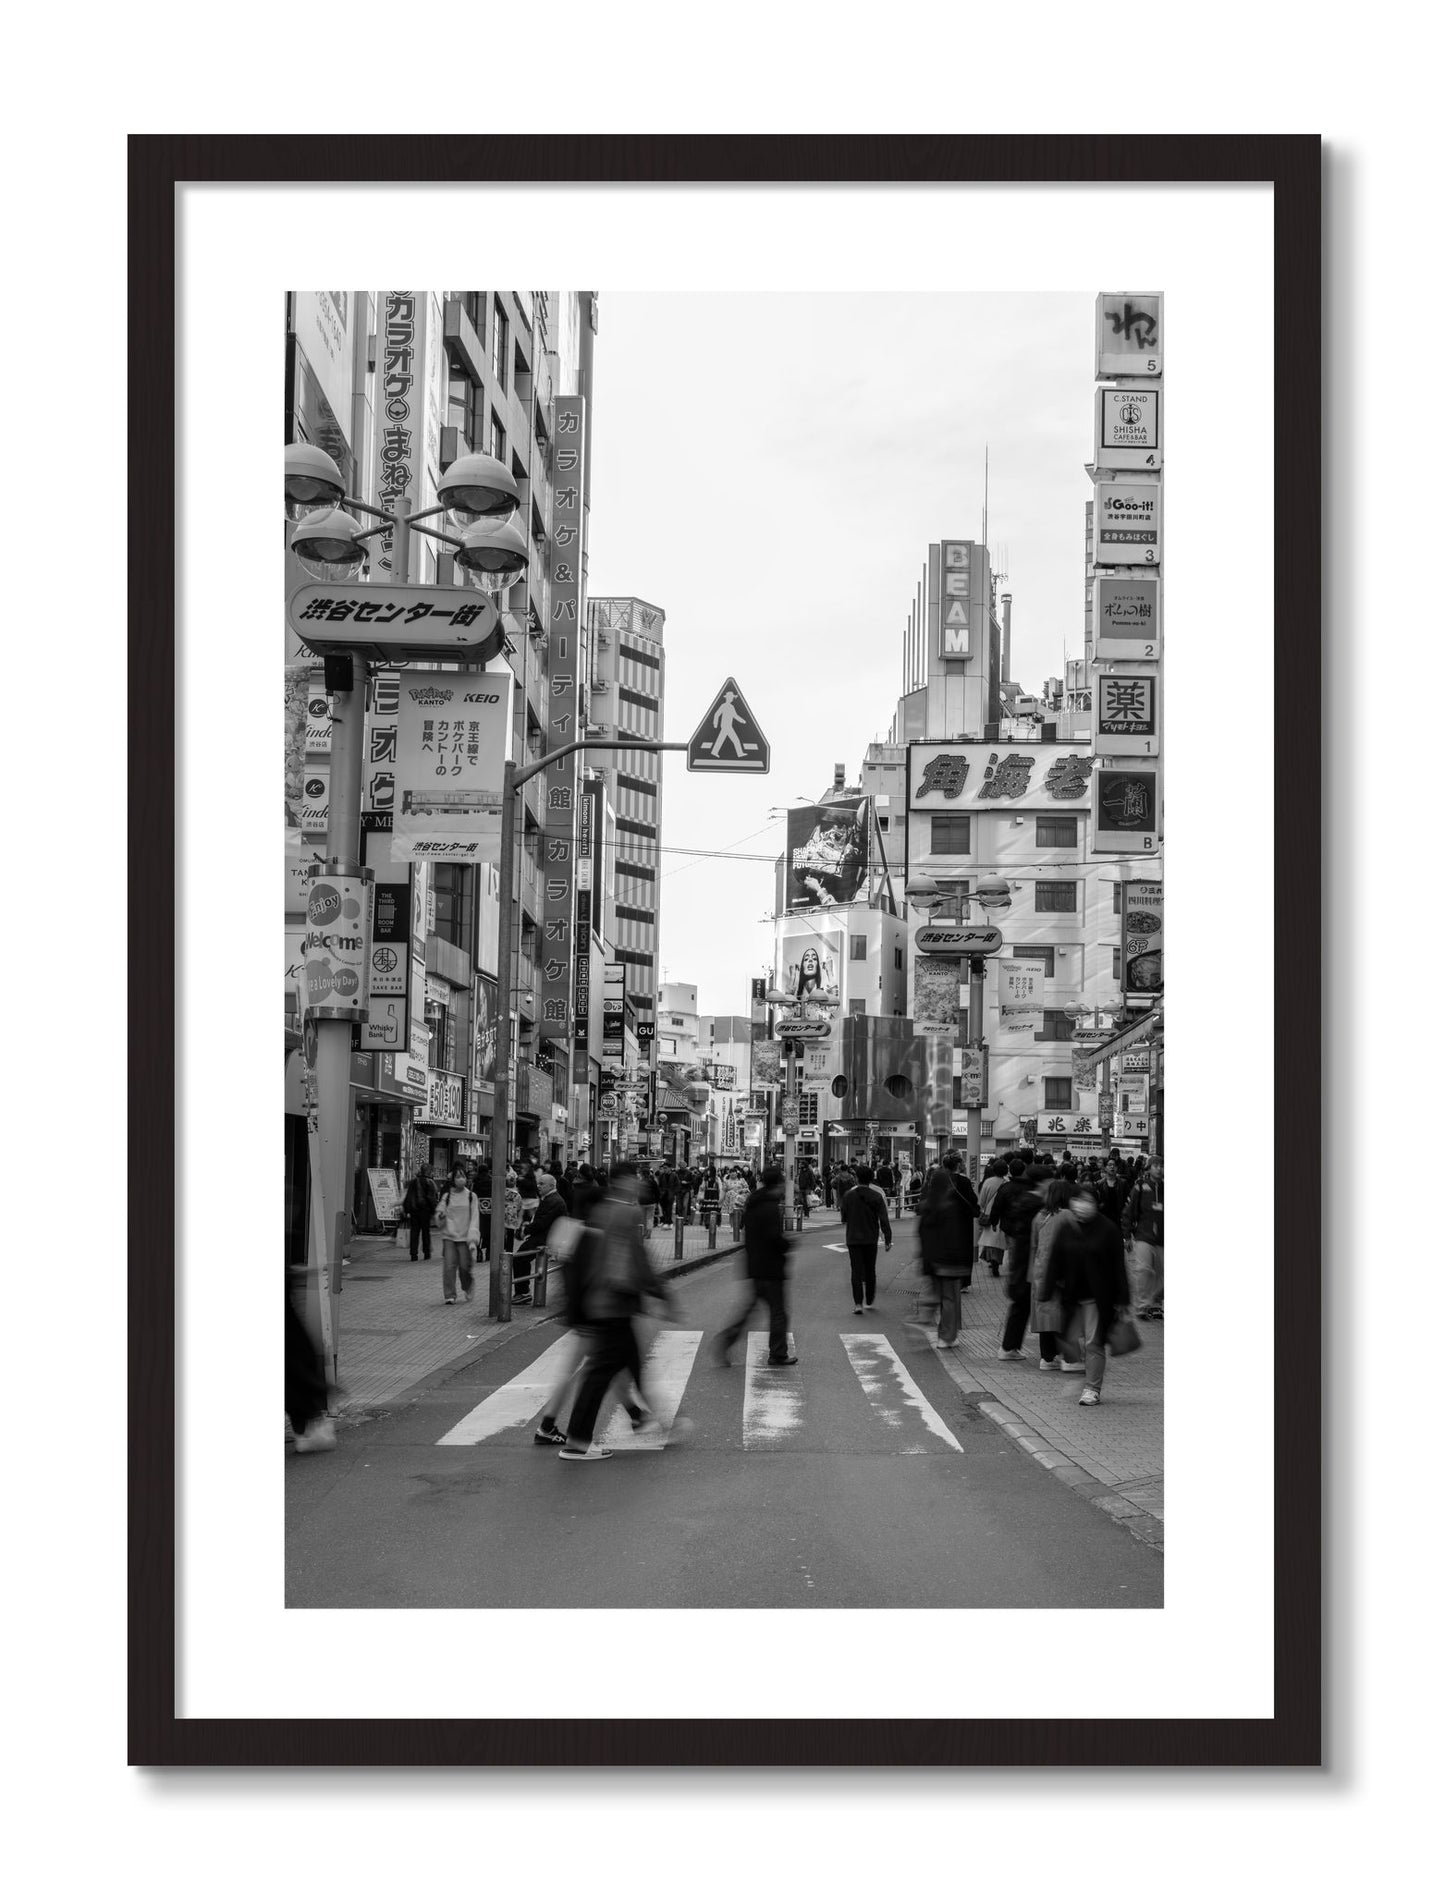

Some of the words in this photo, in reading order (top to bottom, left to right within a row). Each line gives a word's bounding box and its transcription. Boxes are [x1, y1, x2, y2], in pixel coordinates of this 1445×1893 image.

[384, 296, 416, 400] カラオケ
[1147, 360, 1157, 371] 5
[1113, 425, 1147, 434] SHISHA
[1112, 498, 1154, 511] Goo-it!
[1103, 532, 1154, 541] 全身もみほぐし
[1145, 549, 1155, 561] 3
[945, 545, 969, 653] BEAM
[299, 598, 486, 627] 渋谷センター街
[1145, 645, 1154, 656] 2
[463, 693, 500, 704] KEIO
[1107, 681, 1145, 719] 薬
[422, 720, 434, 757] 冒険へ
[467, 720, 480, 766] 京王線で
[435, 720, 449, 776] カントーの
[1145, 740, 1151, 752] 1
[915, 753, 1096, 800] 角海老
[582, 798, 590, 825] kimono
[412, 842, 479, 852] 渋谷センター街
[1144, 837, 1152, 849] B
[309, 894, 339, 921] Enjoy
[305, 932, 363, 950] Welcome
[921, 933, 998, 942] 渋谷センター街
[369, 1024, 394, 1033] Whisky
[639, 1026, 654, 1035] GU
[1048, 1116, 1093, 1133] 兆楽
